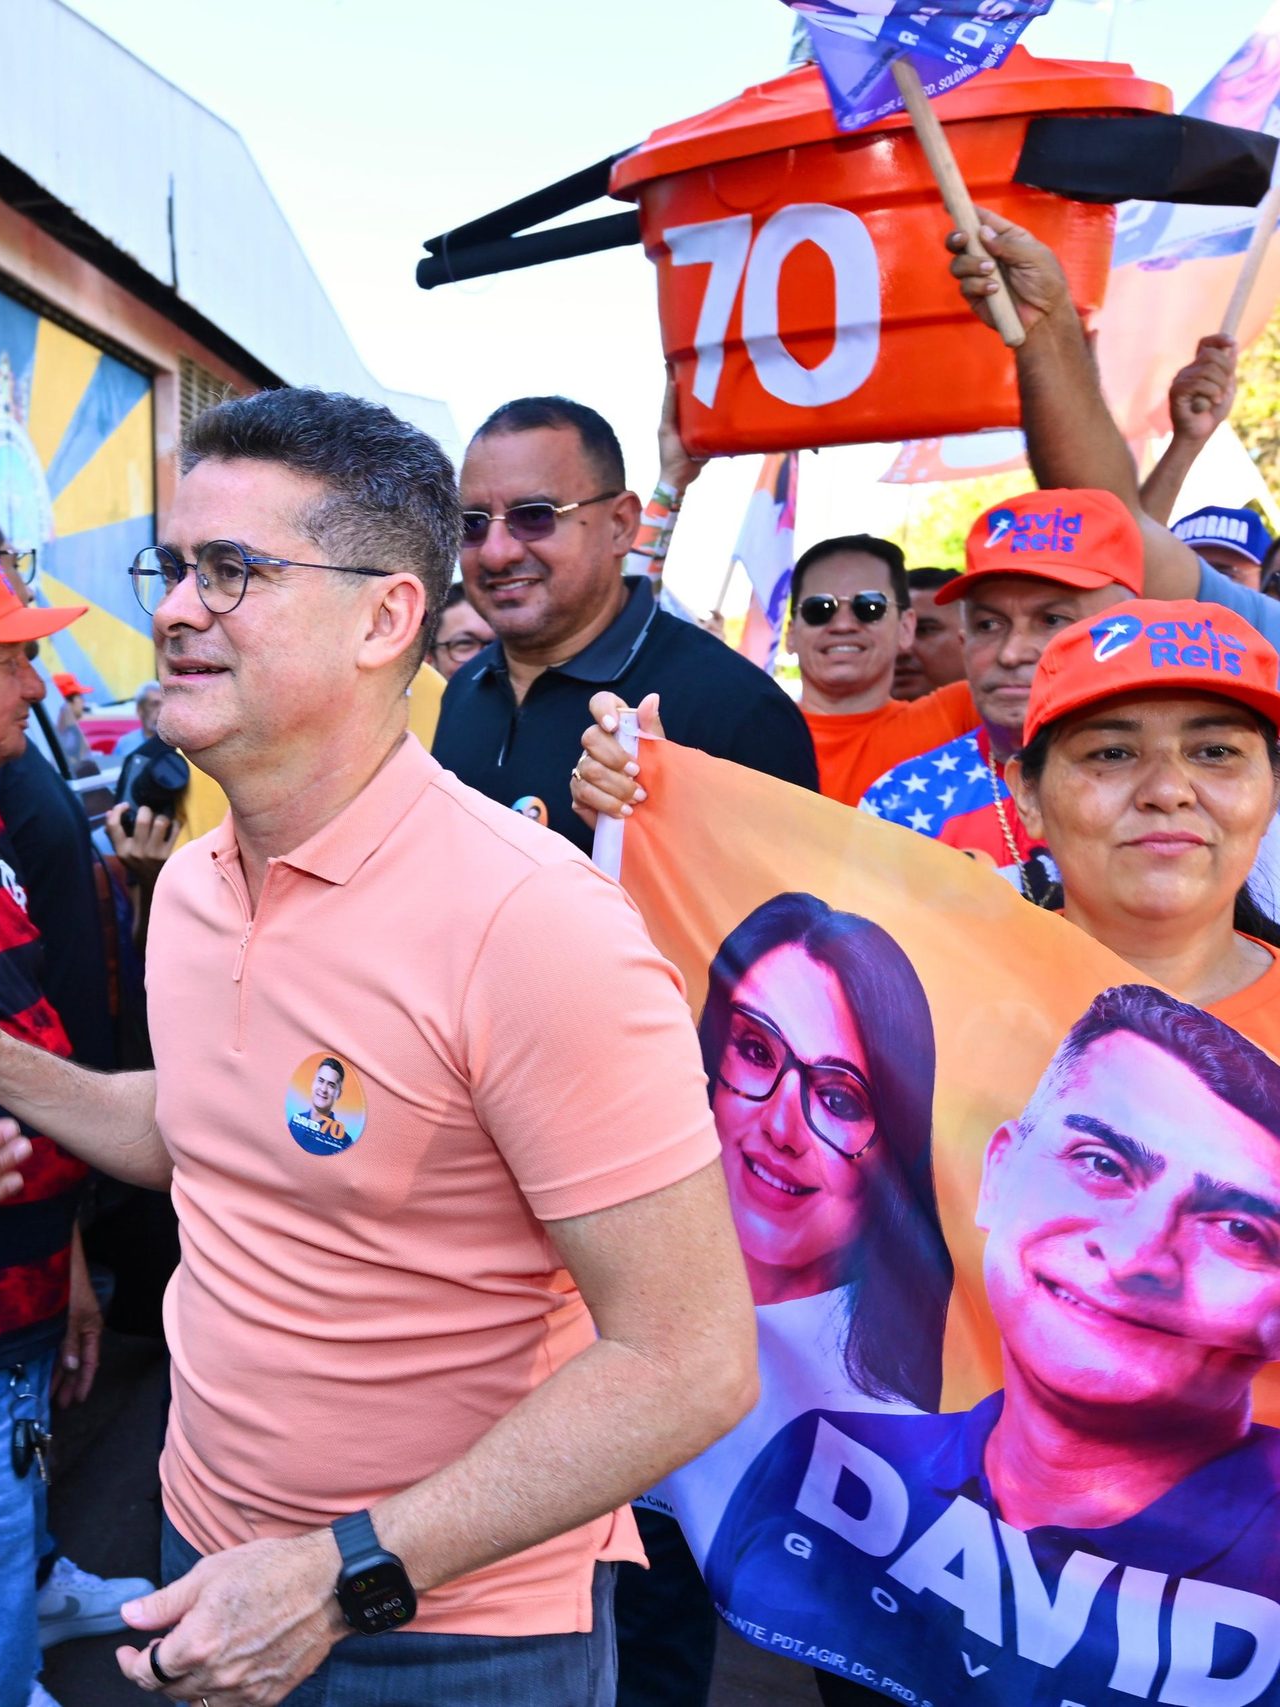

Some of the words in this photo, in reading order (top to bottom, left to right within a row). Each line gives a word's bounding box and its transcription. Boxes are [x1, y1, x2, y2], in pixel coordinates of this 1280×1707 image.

[662, 202, 882, 409] 70
[1010, 533, 1075, 553] Reis
[1149, 641, 1242, 676] Reis
[320, 1114, 345, 1140] 70
[794, 1416, 1280, 1707] DAVID
[771, 1632, 805, 1657] PDT,
[805, 1646, 849, 1673] AGIR,
[850, 1662, 879, 1687] DC,
[880, 1677, 919, 1707] PRD,
